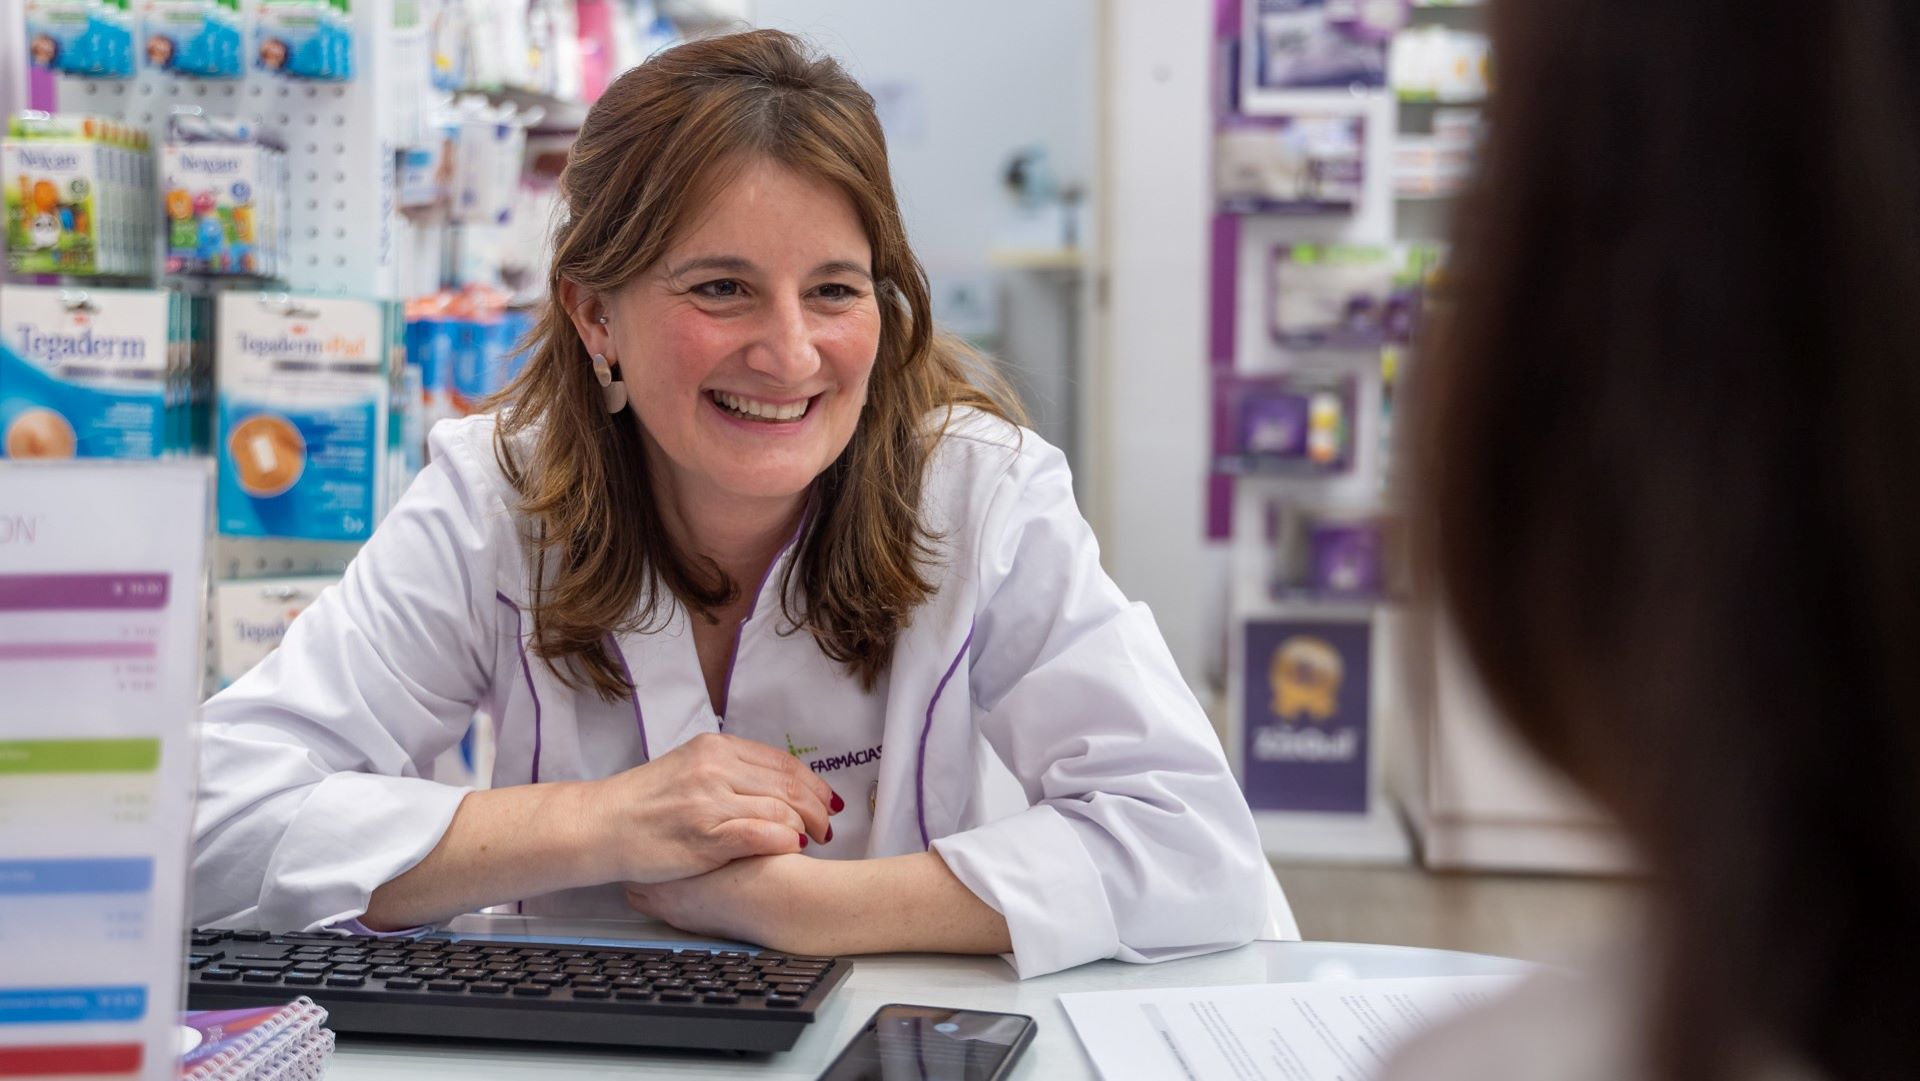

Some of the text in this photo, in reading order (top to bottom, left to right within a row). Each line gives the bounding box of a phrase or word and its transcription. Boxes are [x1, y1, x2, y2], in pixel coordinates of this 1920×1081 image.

[17, 322, 147, 362] Tegaderm
[237, 331, 323, 357] Tegaderm
[810, 745, 883, 773] FARMÁCIAS
